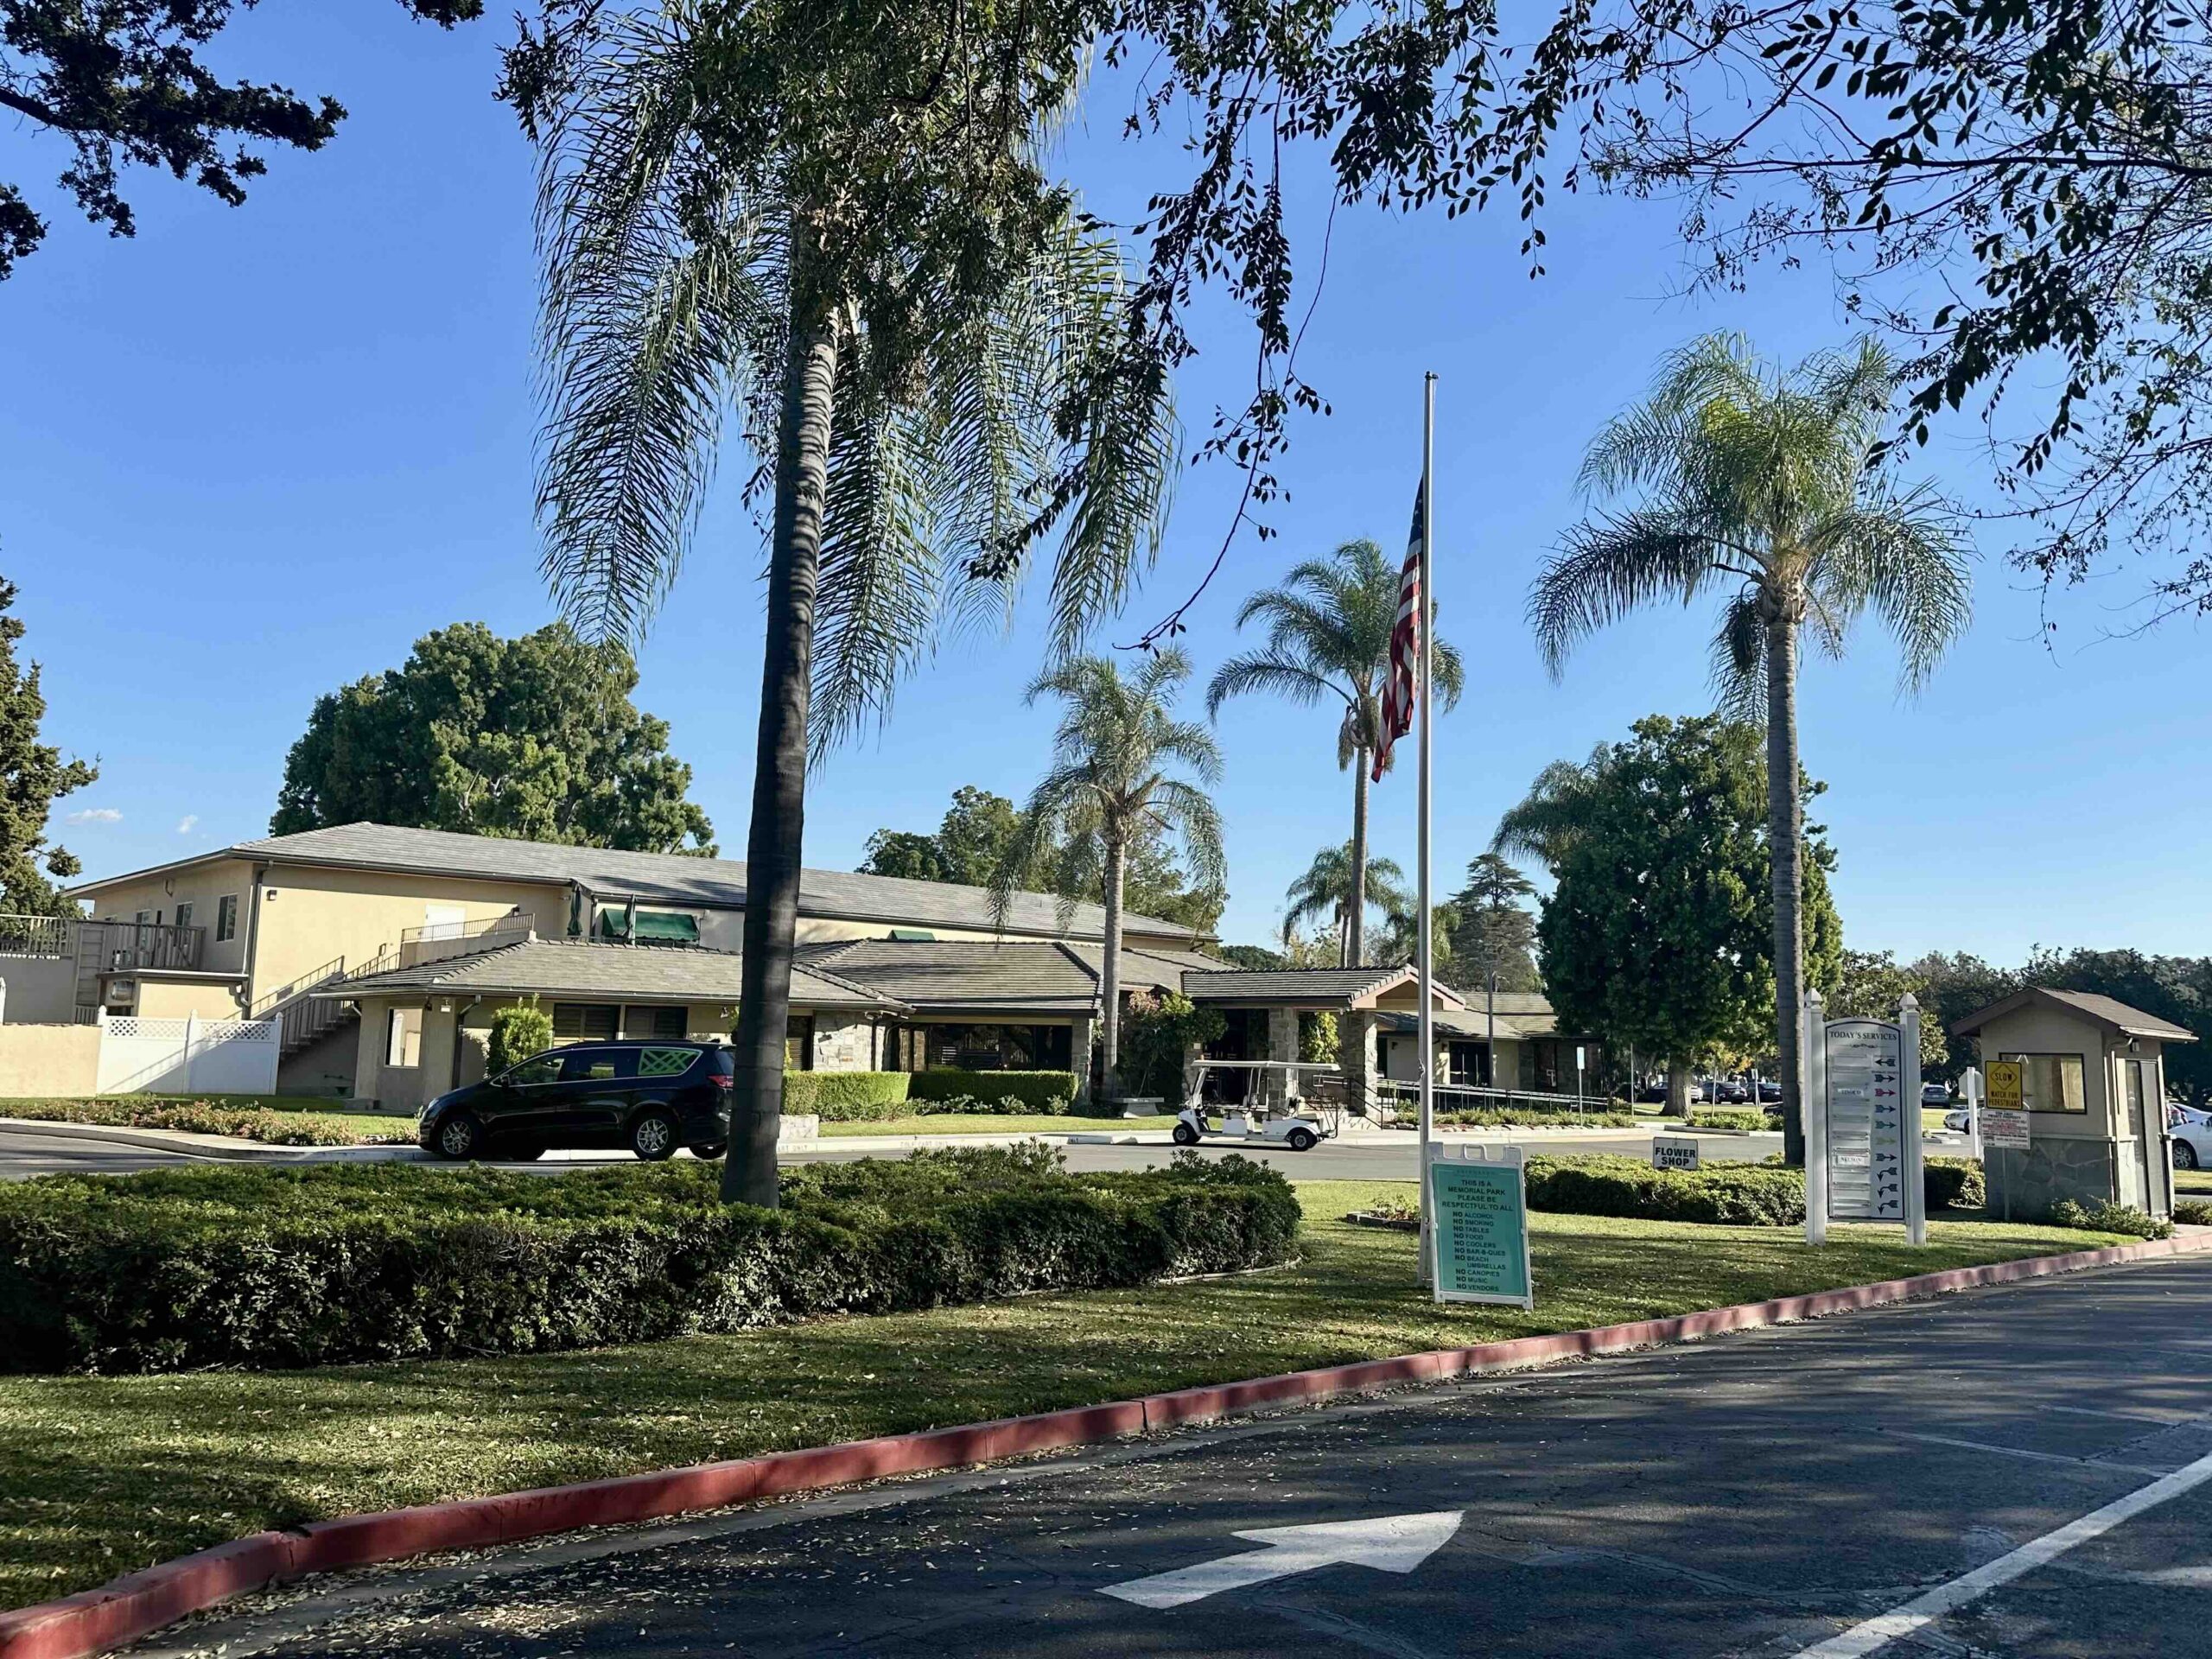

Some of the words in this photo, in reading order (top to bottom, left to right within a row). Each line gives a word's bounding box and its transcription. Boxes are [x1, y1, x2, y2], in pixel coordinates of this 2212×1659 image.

[1829, 1031, 1861, 1039] TODAY'S
[1995, 1072, 2012, 1081] SLOW
[1988, 1098, 2020, 1107] PEDESTRIANS
[1655, 1147, 1696, 1159] FLOWER
[1661, 1156, 1689, 1166] SHOP
[1442, 1201, 1488, 1210] RESPECTFUL
